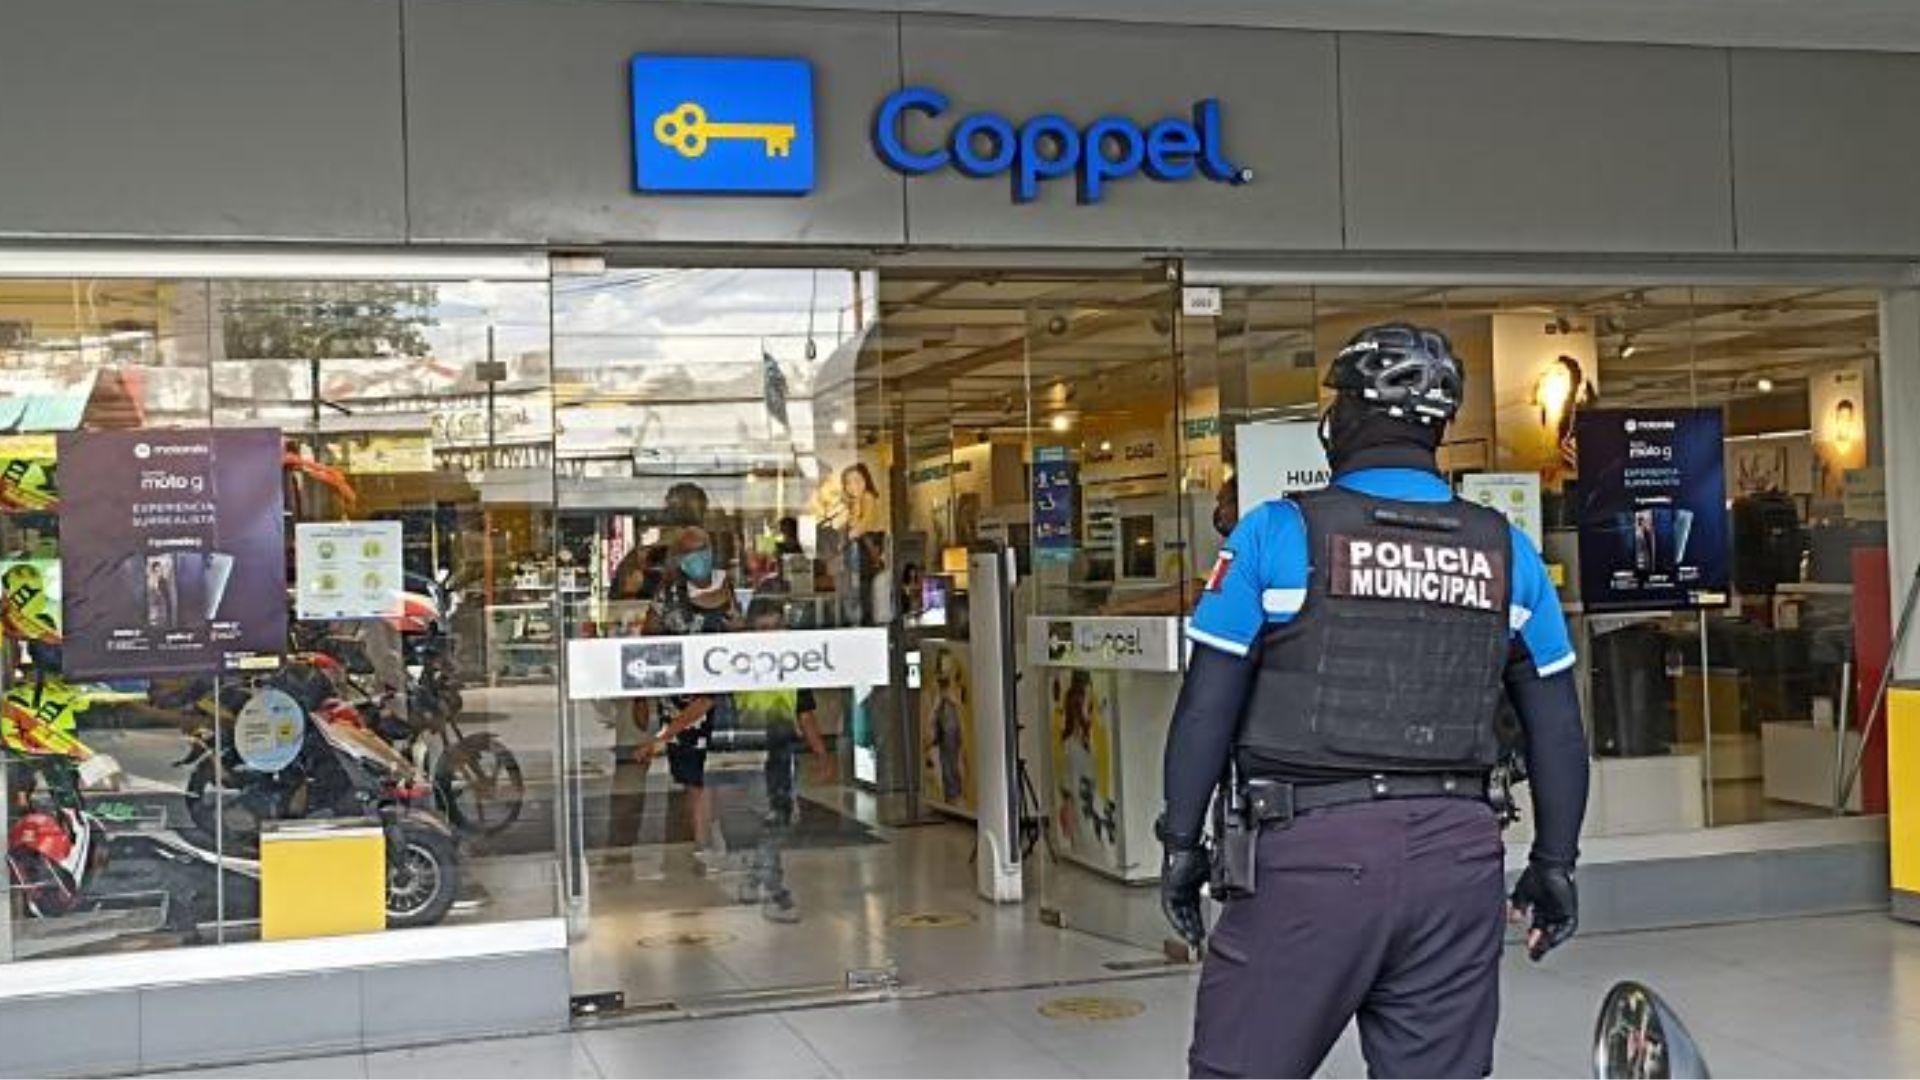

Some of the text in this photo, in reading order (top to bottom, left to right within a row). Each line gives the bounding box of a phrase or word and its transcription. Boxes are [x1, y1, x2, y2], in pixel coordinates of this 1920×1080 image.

[872, 85, 1234, 204] Coppel
[140, 475, 204, 493] moto g
[1286, 470, 1330, 485] HUA
[1350, 541, 1493, 579] POLICIA
[1351, 568, 1492, 609] MUNICIPAL
[702, 643, 835, 682] Coppel
